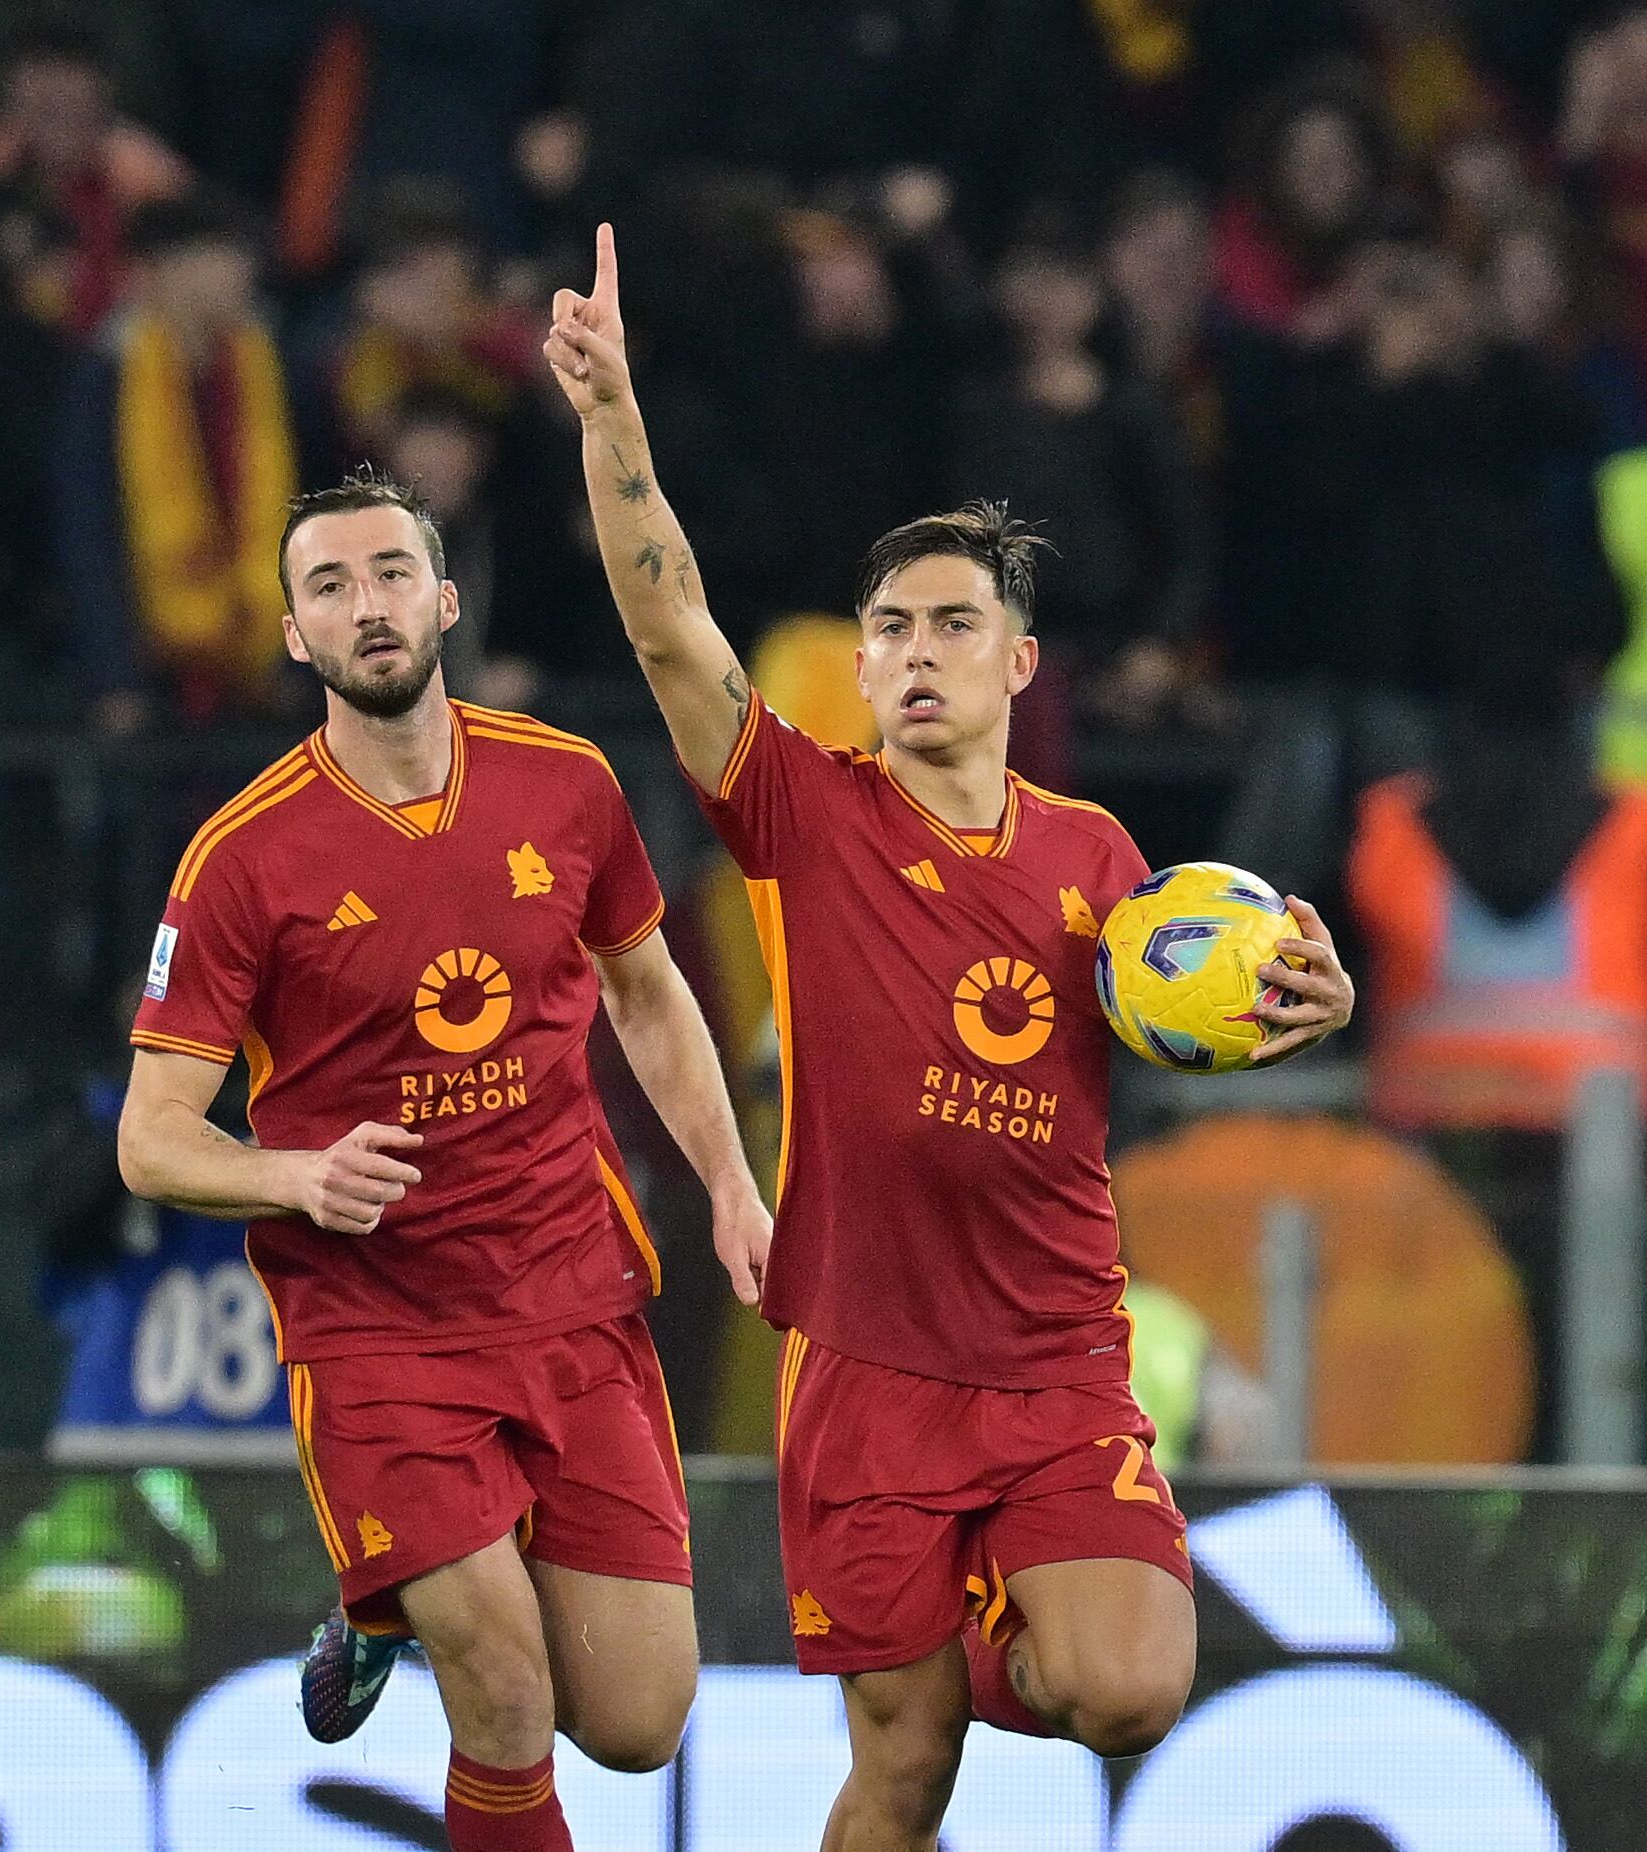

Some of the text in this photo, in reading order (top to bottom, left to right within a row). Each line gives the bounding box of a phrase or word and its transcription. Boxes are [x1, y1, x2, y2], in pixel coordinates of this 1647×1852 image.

[400, 1056, 524, 1097] RIYADH
[923, 1065, 1058, 1116] RIYADH
[399, 1084, 528, 1124] SEASON
[918, 1093, 1054, 1144] SEASON
[1093, 1434, 1168, 1508] 2
